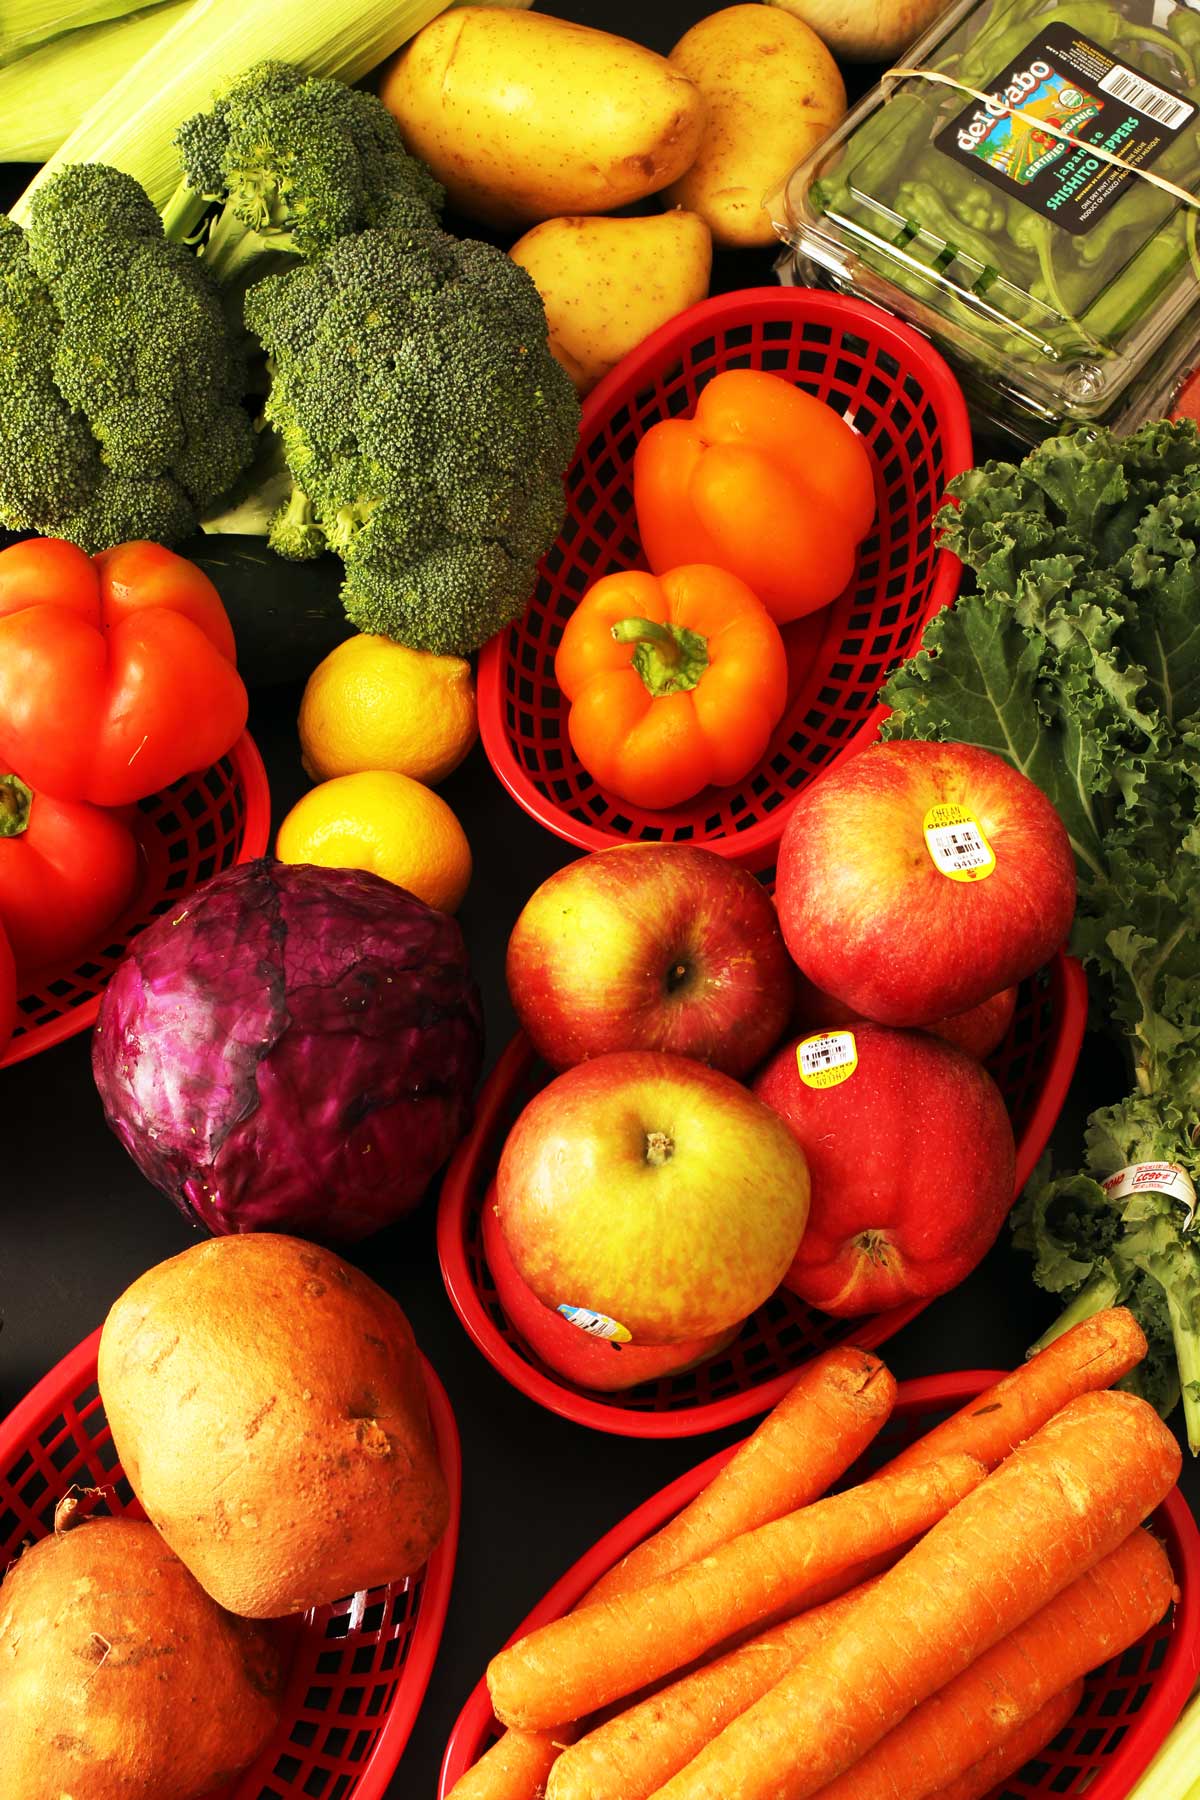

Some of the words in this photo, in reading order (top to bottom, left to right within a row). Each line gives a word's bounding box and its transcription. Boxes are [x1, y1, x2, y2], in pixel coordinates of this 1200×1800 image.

[1025, 142, 1065, 178] CERTIFIED
[1061, 108, 1095, 134] RGANIC
[1053, 132, 1104, 182] japanse
[1046, 159, 1099, 210] SHISHITO
[1100, 117, 1139, 161] EPPERS
[1081, 200, 1092, 210] ONE
[1089, 192, 1099, 201] DRY
[1097, 181, 1109, 192] PINT
[1079, 202, 1098, 222] PRODUCT
[928, 817, 972, 829] ORGANIC
[954, 858, 984, 869] 94135
